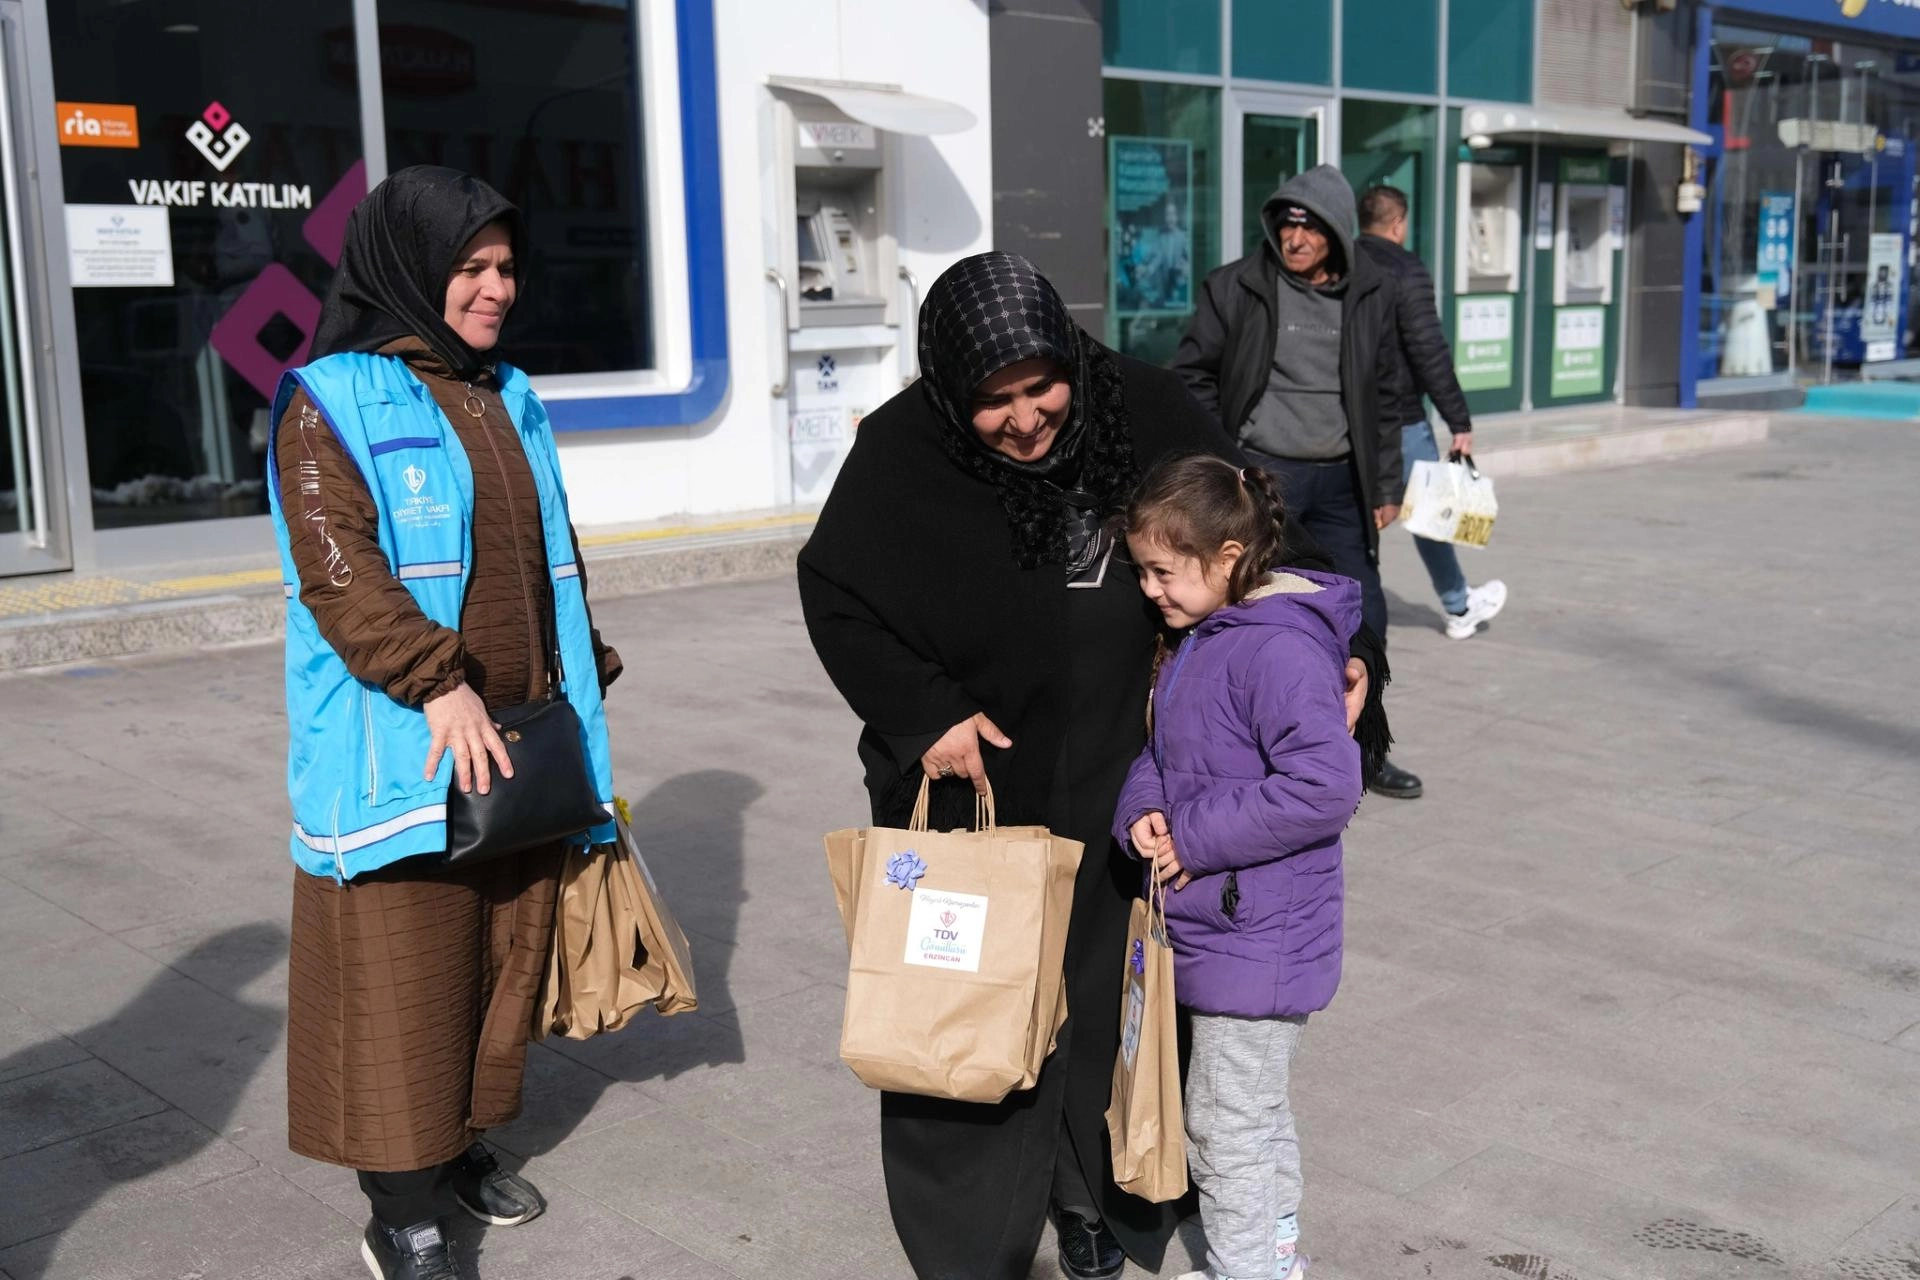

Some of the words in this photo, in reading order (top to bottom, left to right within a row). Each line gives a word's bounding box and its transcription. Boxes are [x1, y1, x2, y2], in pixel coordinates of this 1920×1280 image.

[64, 109, 101, 136] ria
[128, 179, 205, 206] VAKIF
[210, 182, 312, 209] KATILIM
[933, 928, 959, 941] TDV
